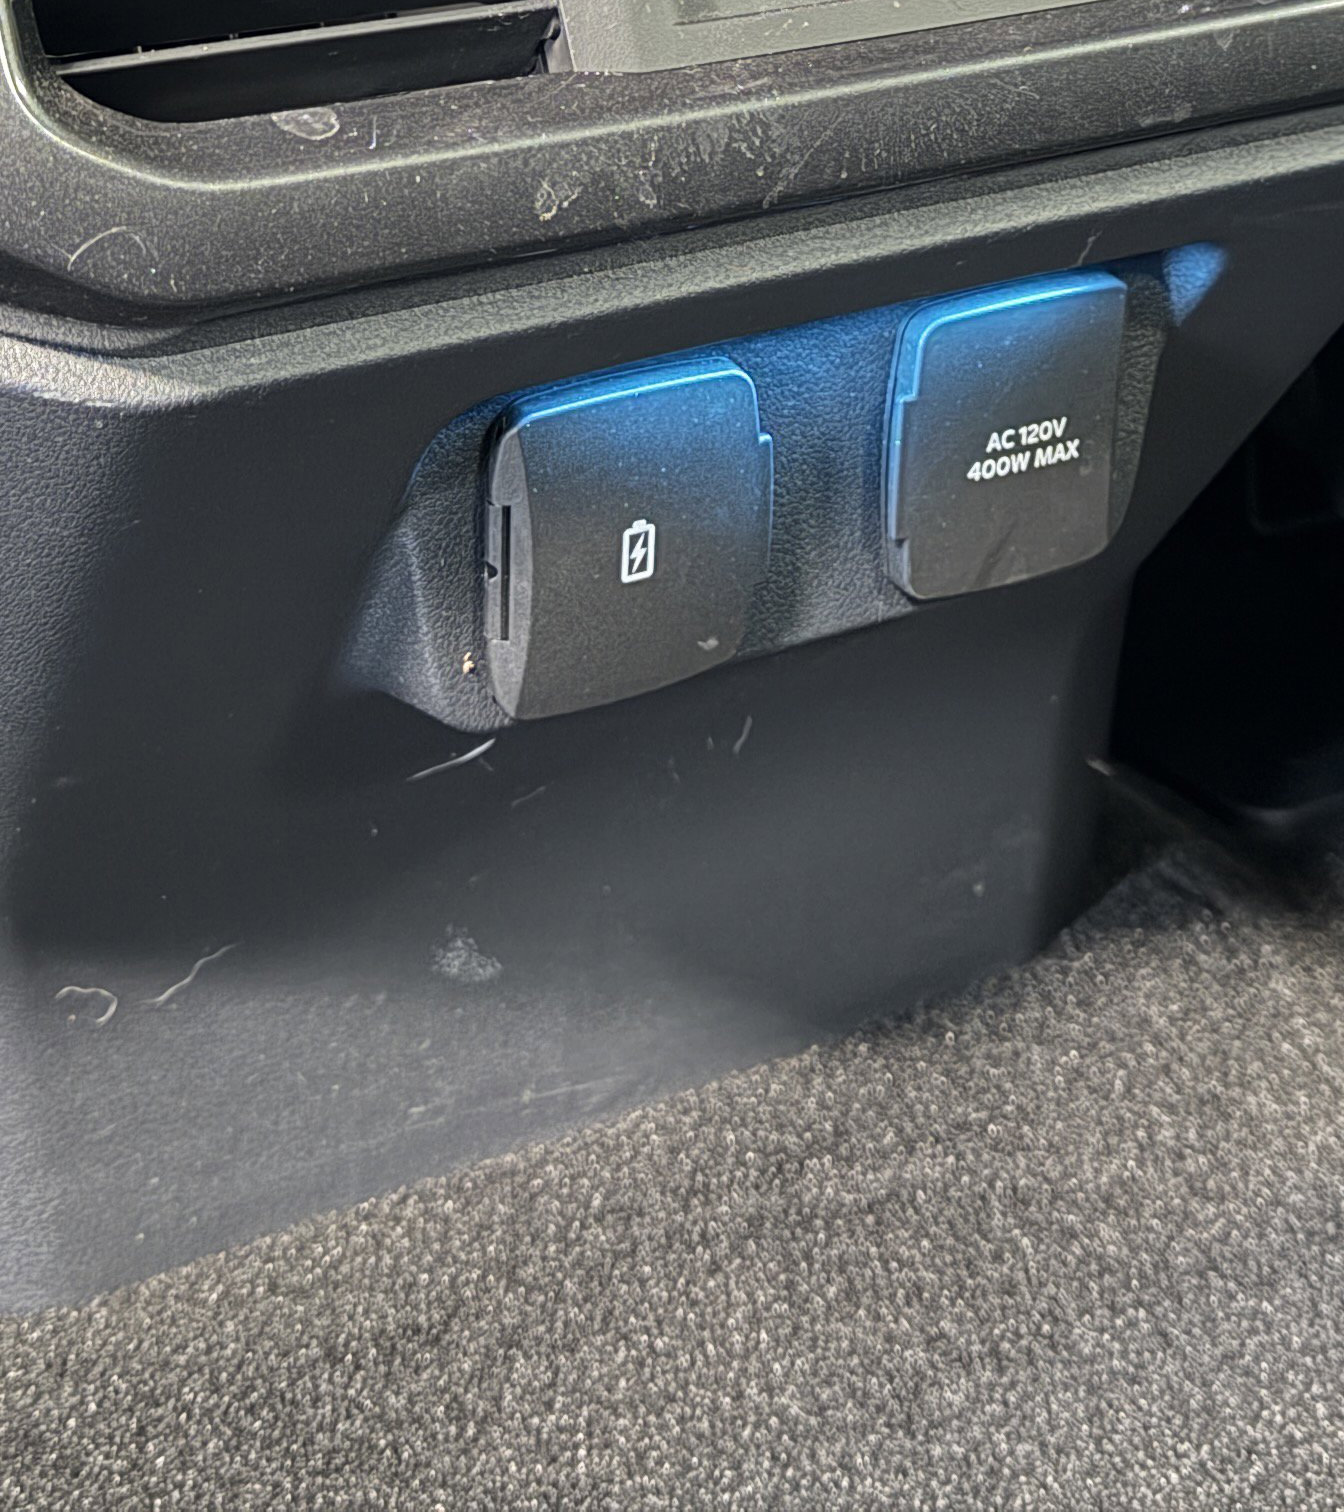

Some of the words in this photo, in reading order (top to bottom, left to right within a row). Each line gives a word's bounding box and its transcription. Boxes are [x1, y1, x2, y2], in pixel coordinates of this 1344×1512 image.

[986, 429, 1015, 453] AC
[1018, 416, 1067, 446] 120V
[966, 451, 1031, 482] 400W
[1034, 438, 1080, 469] MAX
